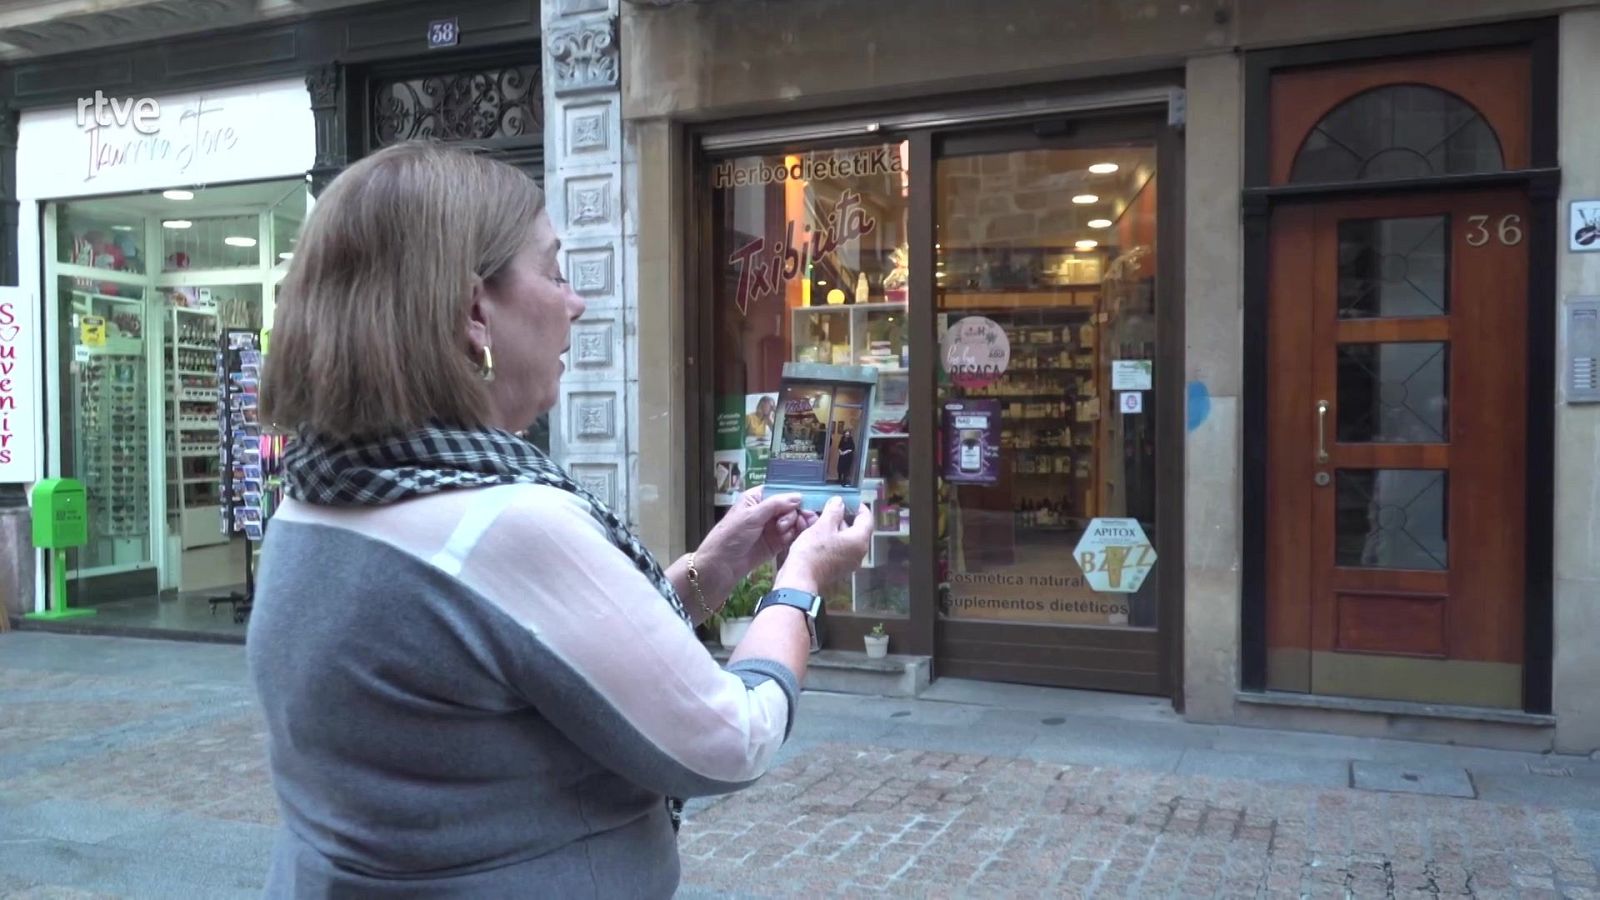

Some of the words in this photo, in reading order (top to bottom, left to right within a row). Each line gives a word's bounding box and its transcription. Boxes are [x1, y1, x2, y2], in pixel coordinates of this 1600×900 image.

[432, 22, 454, 43] 38
[1465, 214, 1522, 246] 36
[1093, 527, 1136, 537] APITOX
[1030, 574, 1085, 588] natural
